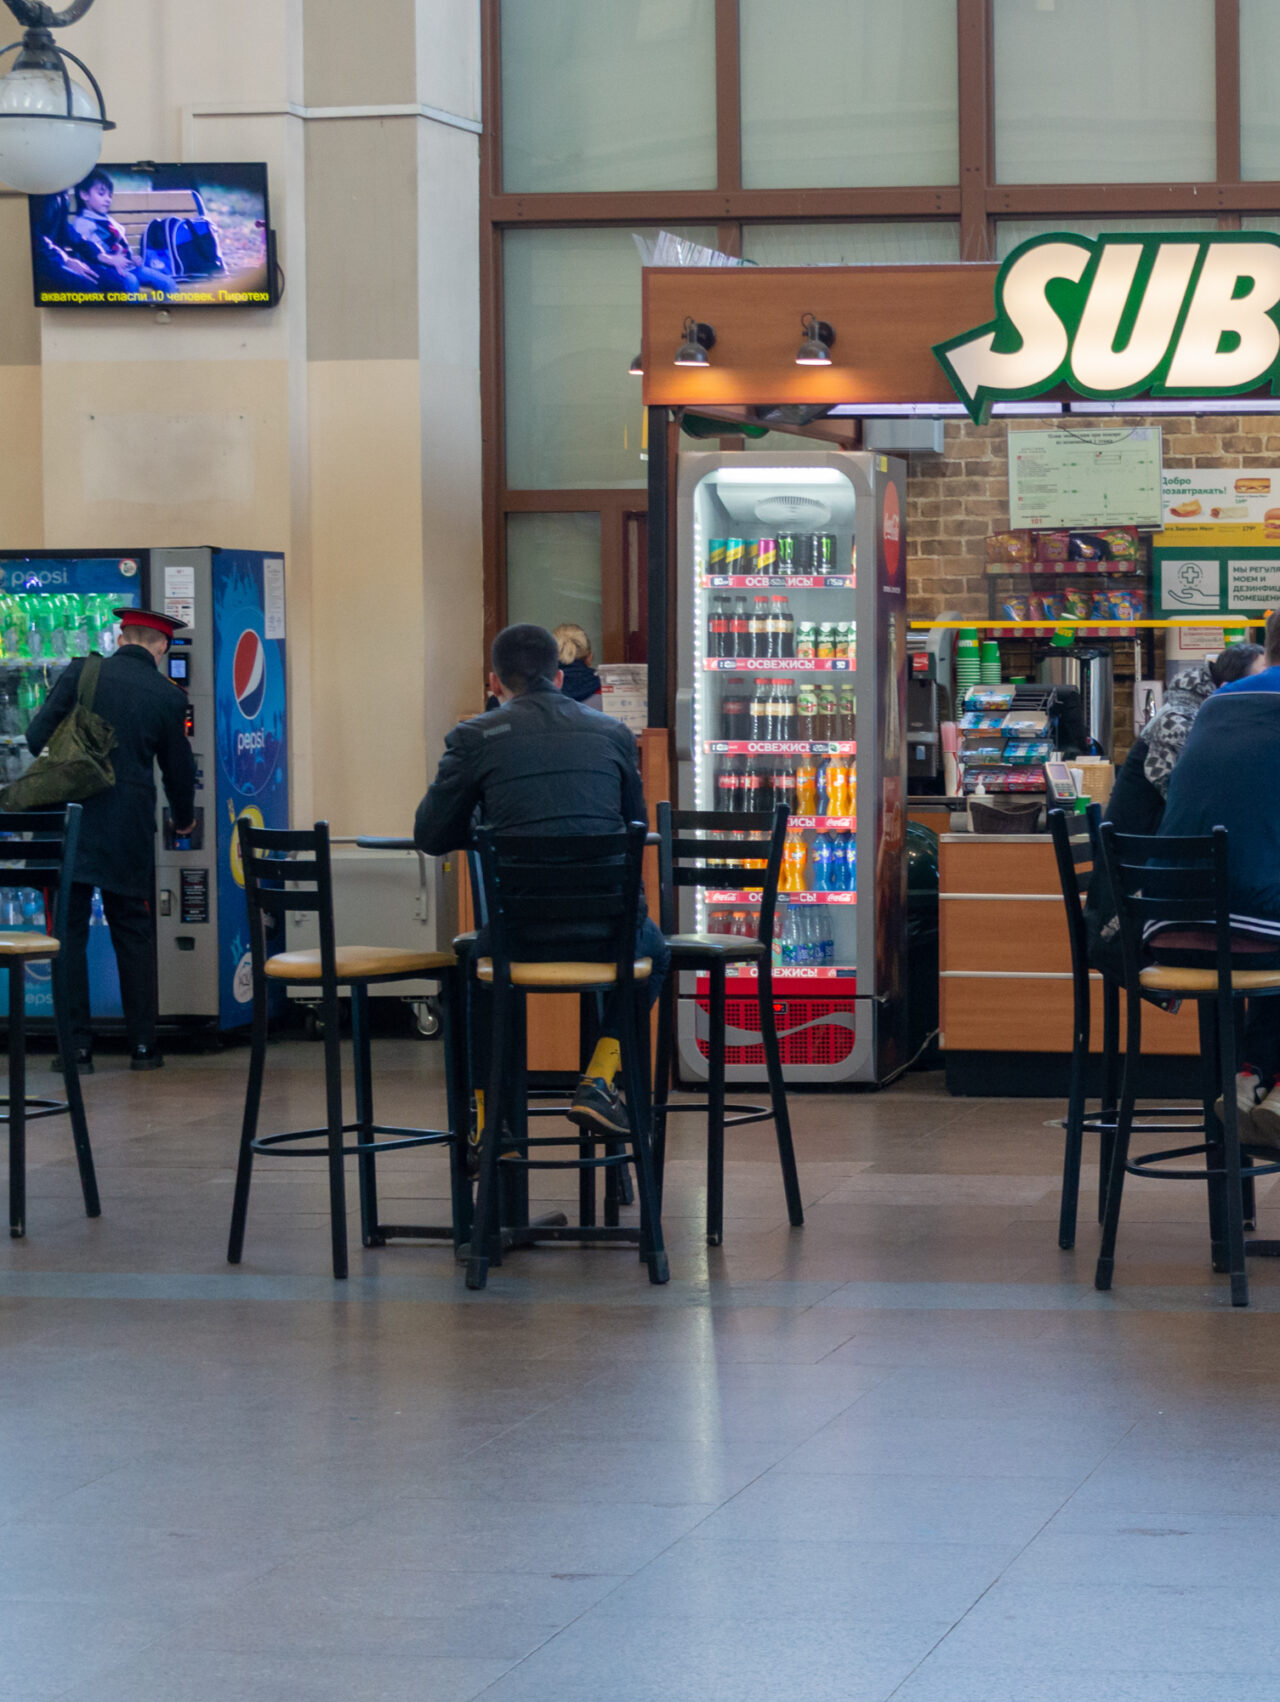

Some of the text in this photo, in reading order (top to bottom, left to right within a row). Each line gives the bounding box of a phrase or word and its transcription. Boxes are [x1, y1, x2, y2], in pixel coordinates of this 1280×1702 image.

[41, 291, 104, 303] акваториях
[107, 291, 147, 302] спасли
[150, 290, 164, 302] 10
[167, 291, 215, 302] человек.
[11, 568, 68, 587] pepsi
[745, 577, 814, 586] ОСВИСЬ!
[747, 660, 815, 669] ОСВЕЖИСЬ!
[237, 727, 265, 754] pepsi
[749, 968, 818, 977] ОЕЖИСЬ!
[25, 993, 53, 1006] eps
